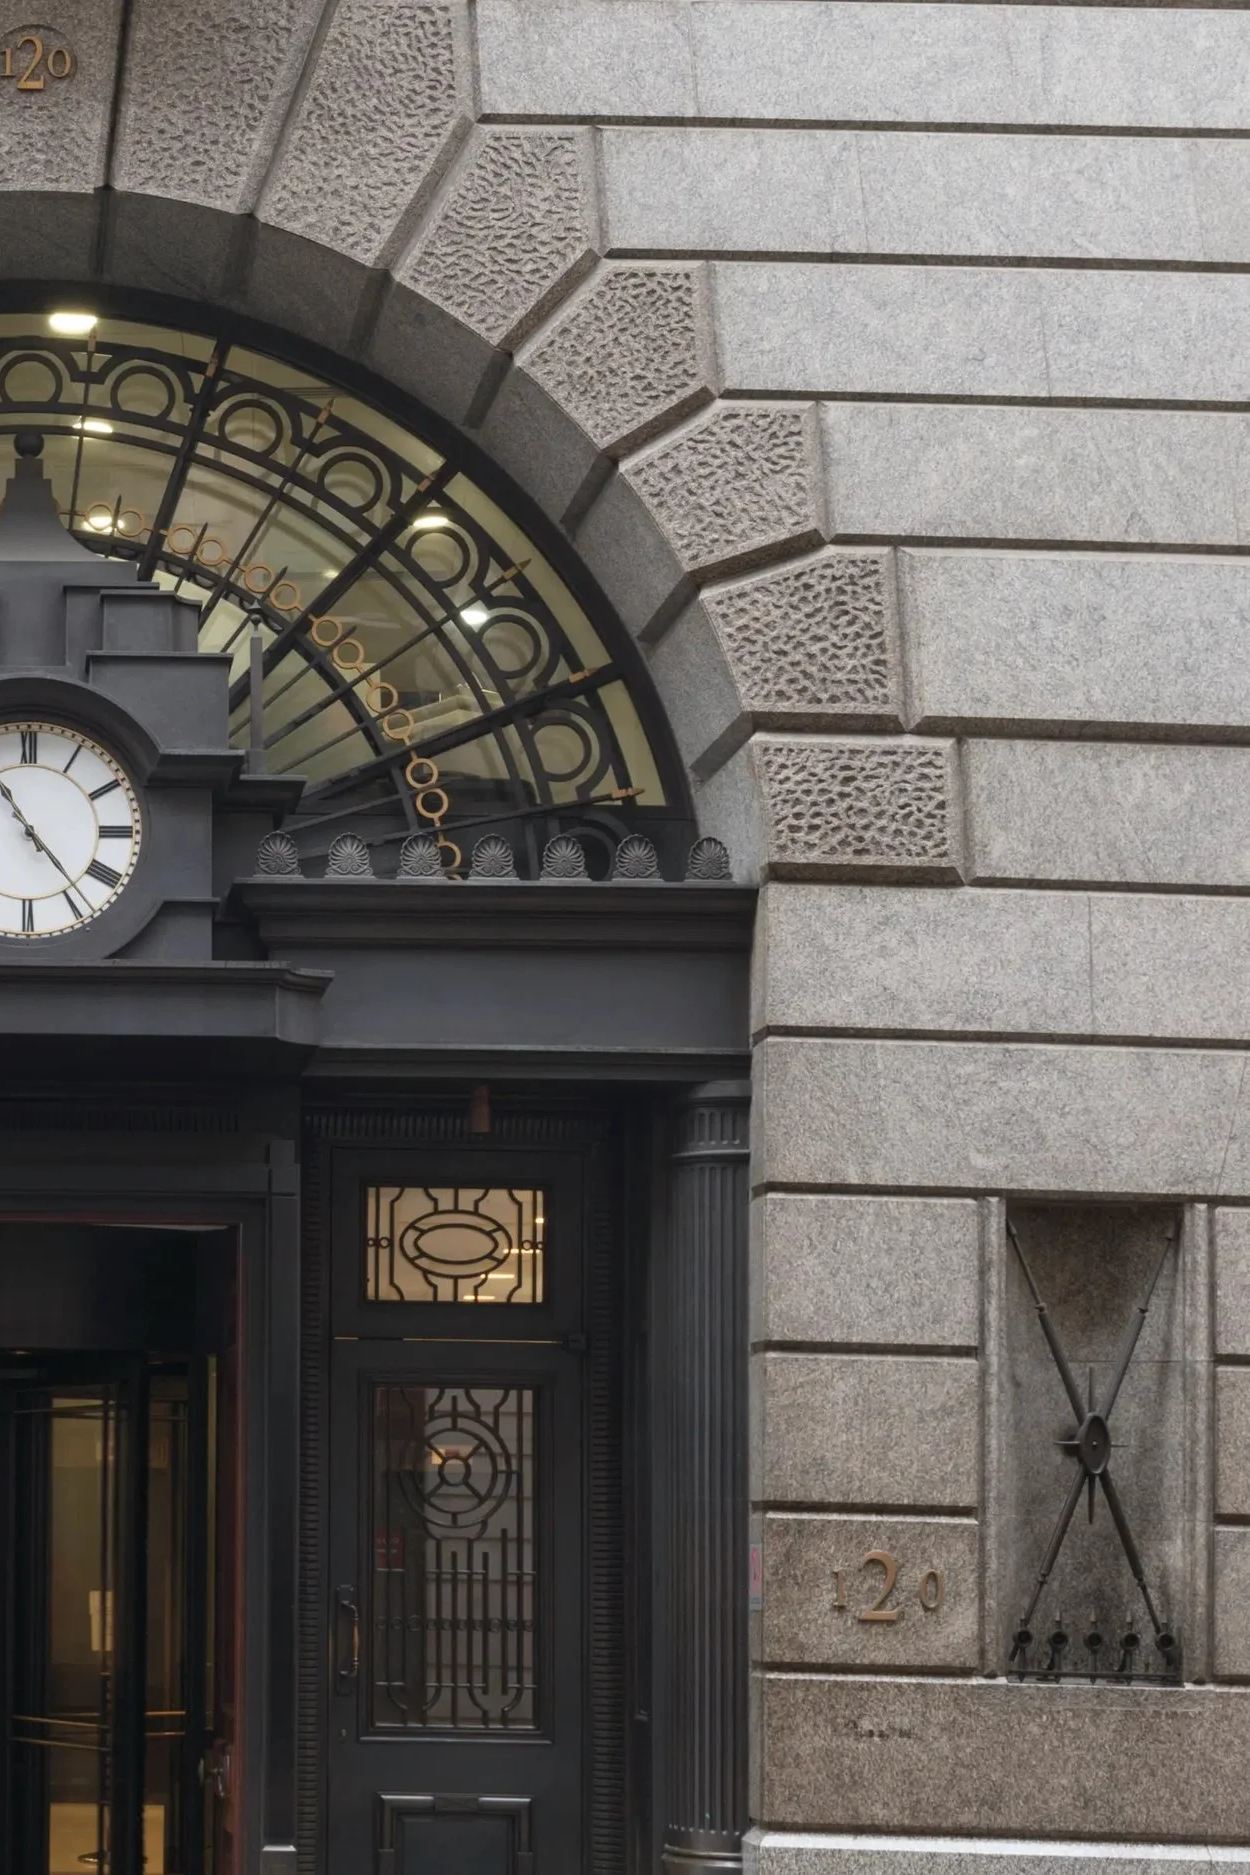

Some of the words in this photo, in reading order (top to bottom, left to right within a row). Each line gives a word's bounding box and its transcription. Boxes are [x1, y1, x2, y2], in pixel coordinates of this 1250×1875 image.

[20, 731, 37, 764] XII
[63, 744, 81, 773] I
[89, 779, 122, 800] II
[98, 824, 134, 838] III
[832, 1548, 946, 1621] 120
